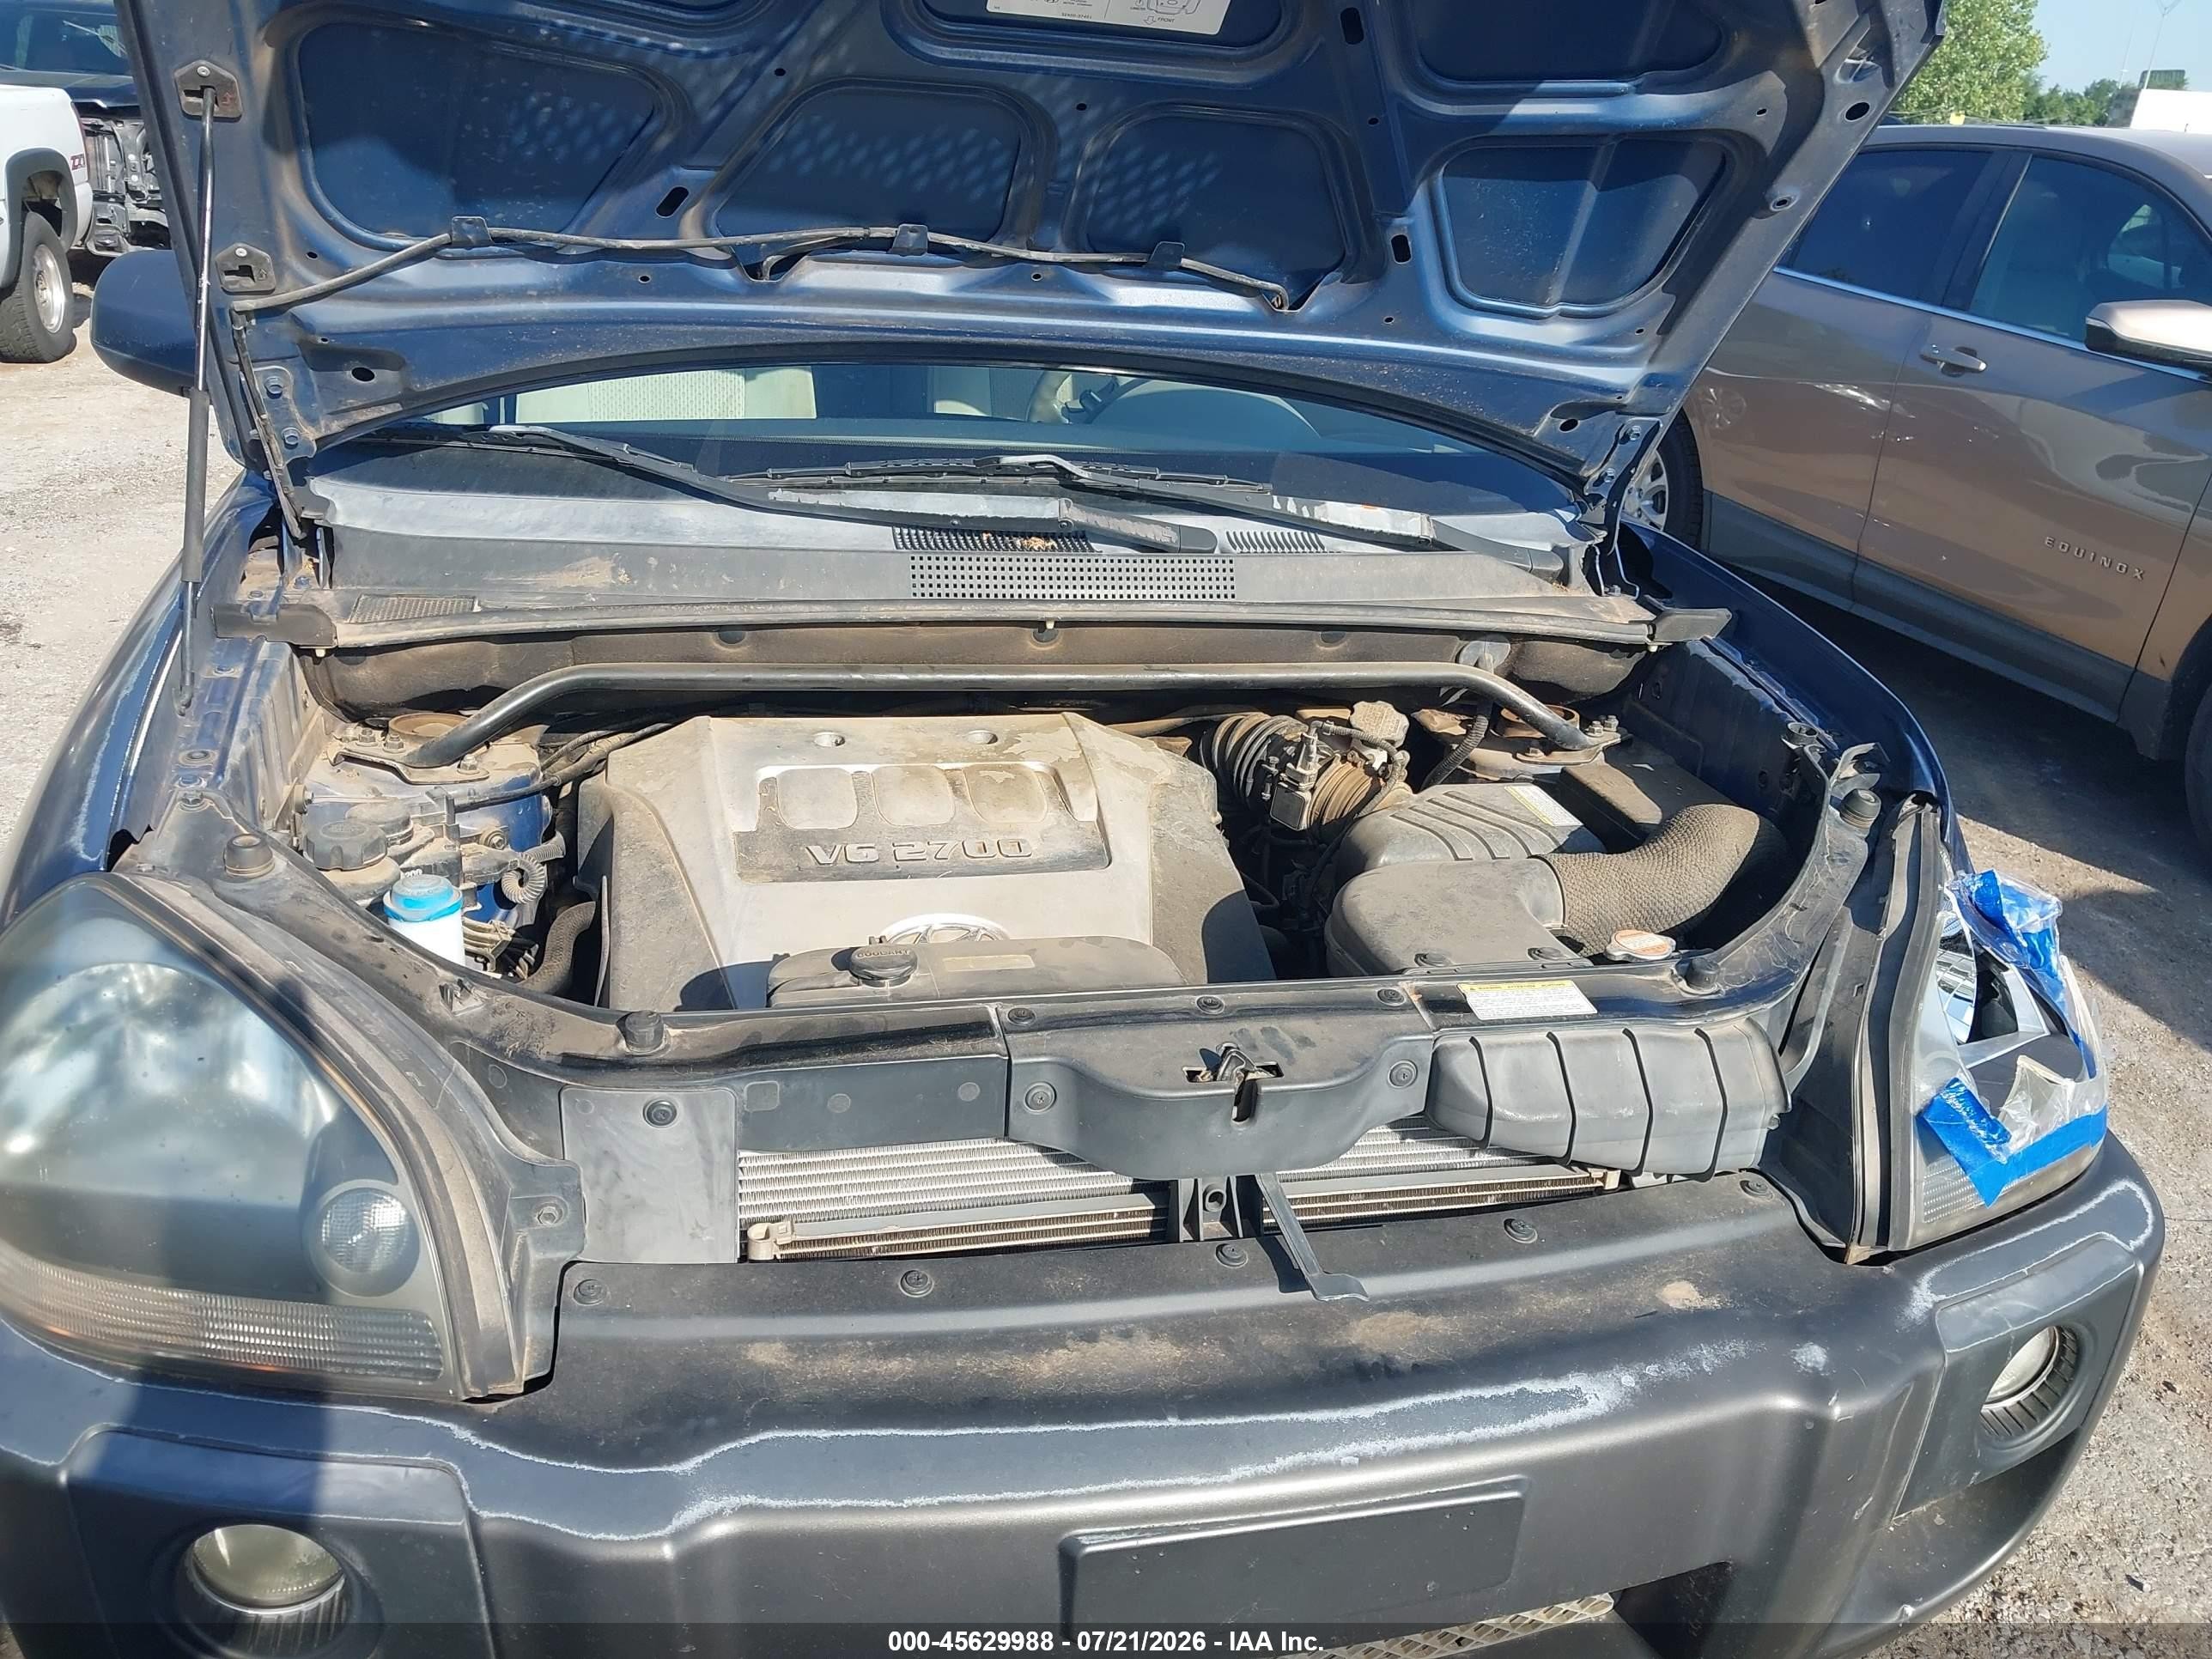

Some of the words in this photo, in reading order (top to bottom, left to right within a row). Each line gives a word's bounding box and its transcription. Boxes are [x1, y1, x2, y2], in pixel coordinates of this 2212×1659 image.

[2045, 536, 2145, 581] EQUINOX
[805, 843, 879, 866] V6
[891, 838, 1032, 861] 2700
